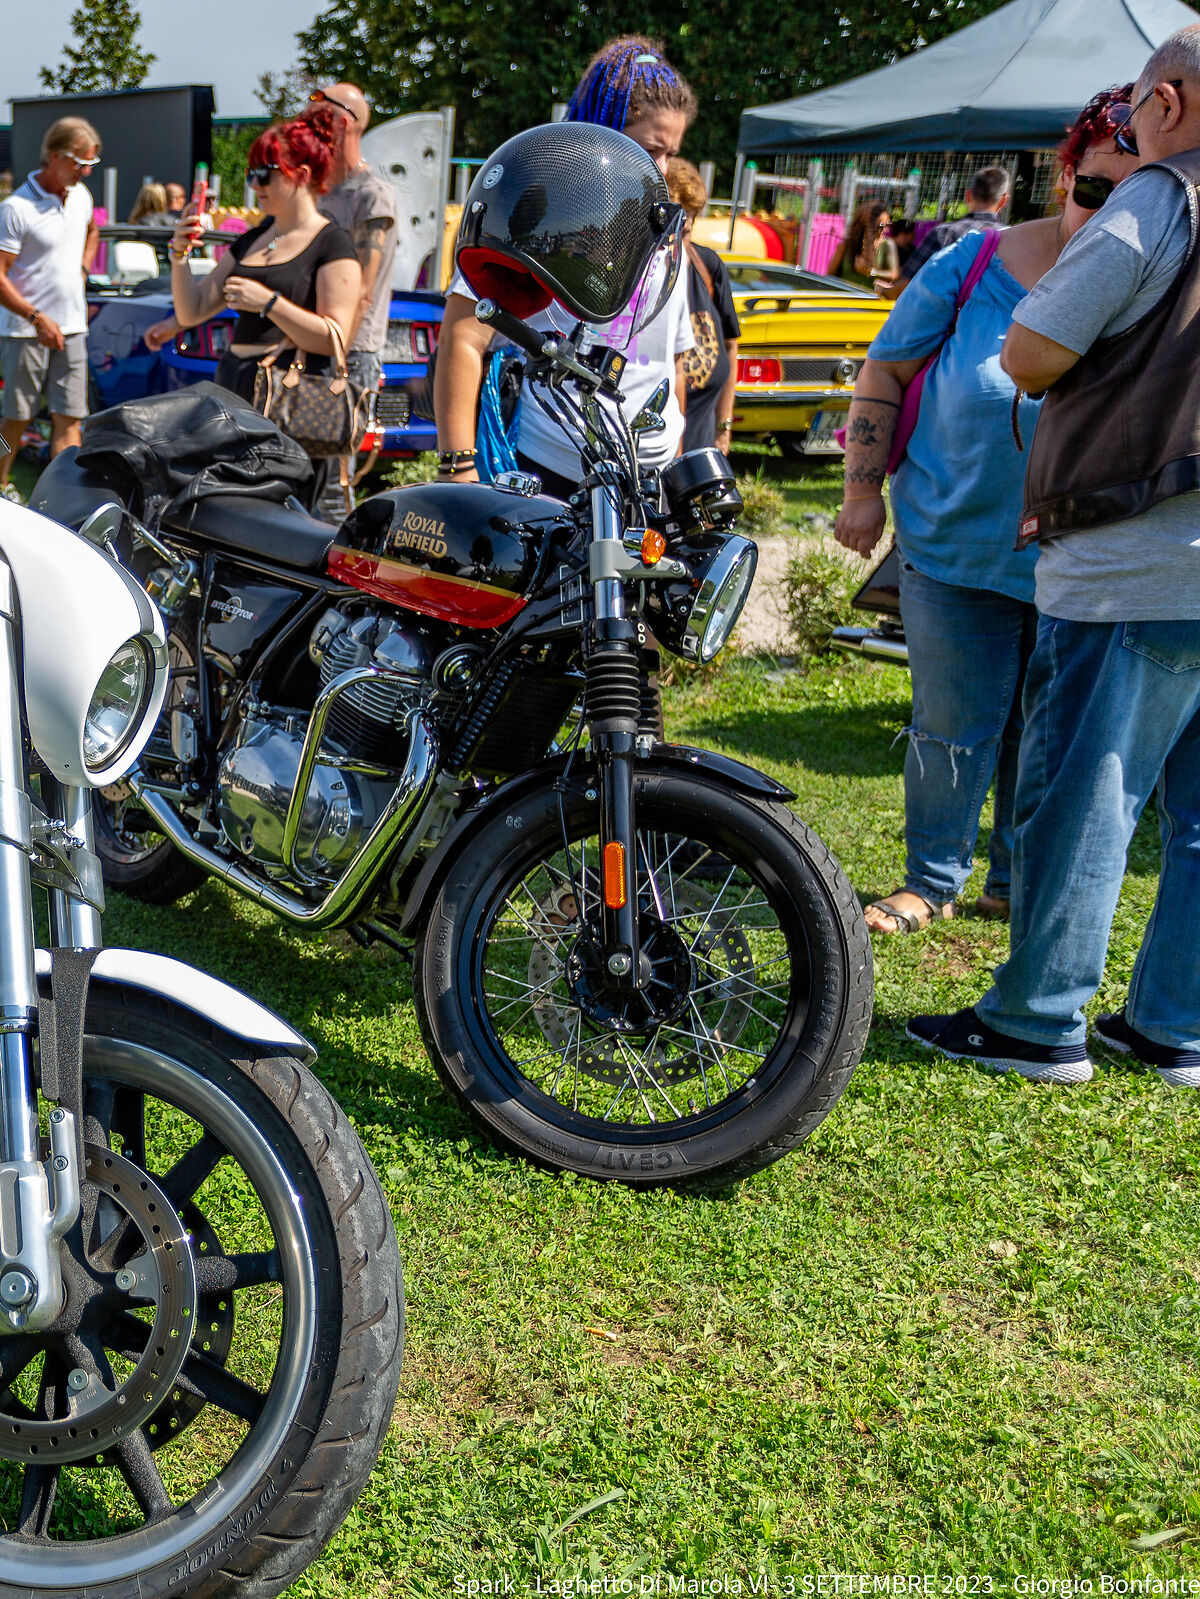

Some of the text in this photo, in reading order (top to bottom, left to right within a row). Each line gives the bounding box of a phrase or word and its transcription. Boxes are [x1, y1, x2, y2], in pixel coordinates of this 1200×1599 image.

[402, 511, 446, 538] ROYAL
[393, 529, 448, 559] ENFIELD
[210, 599, 254, 621] INTERCEPTOR
[601, 1151, 674, 1171] CEAT
[167, 1479, 278, 1587] DUNLOP
